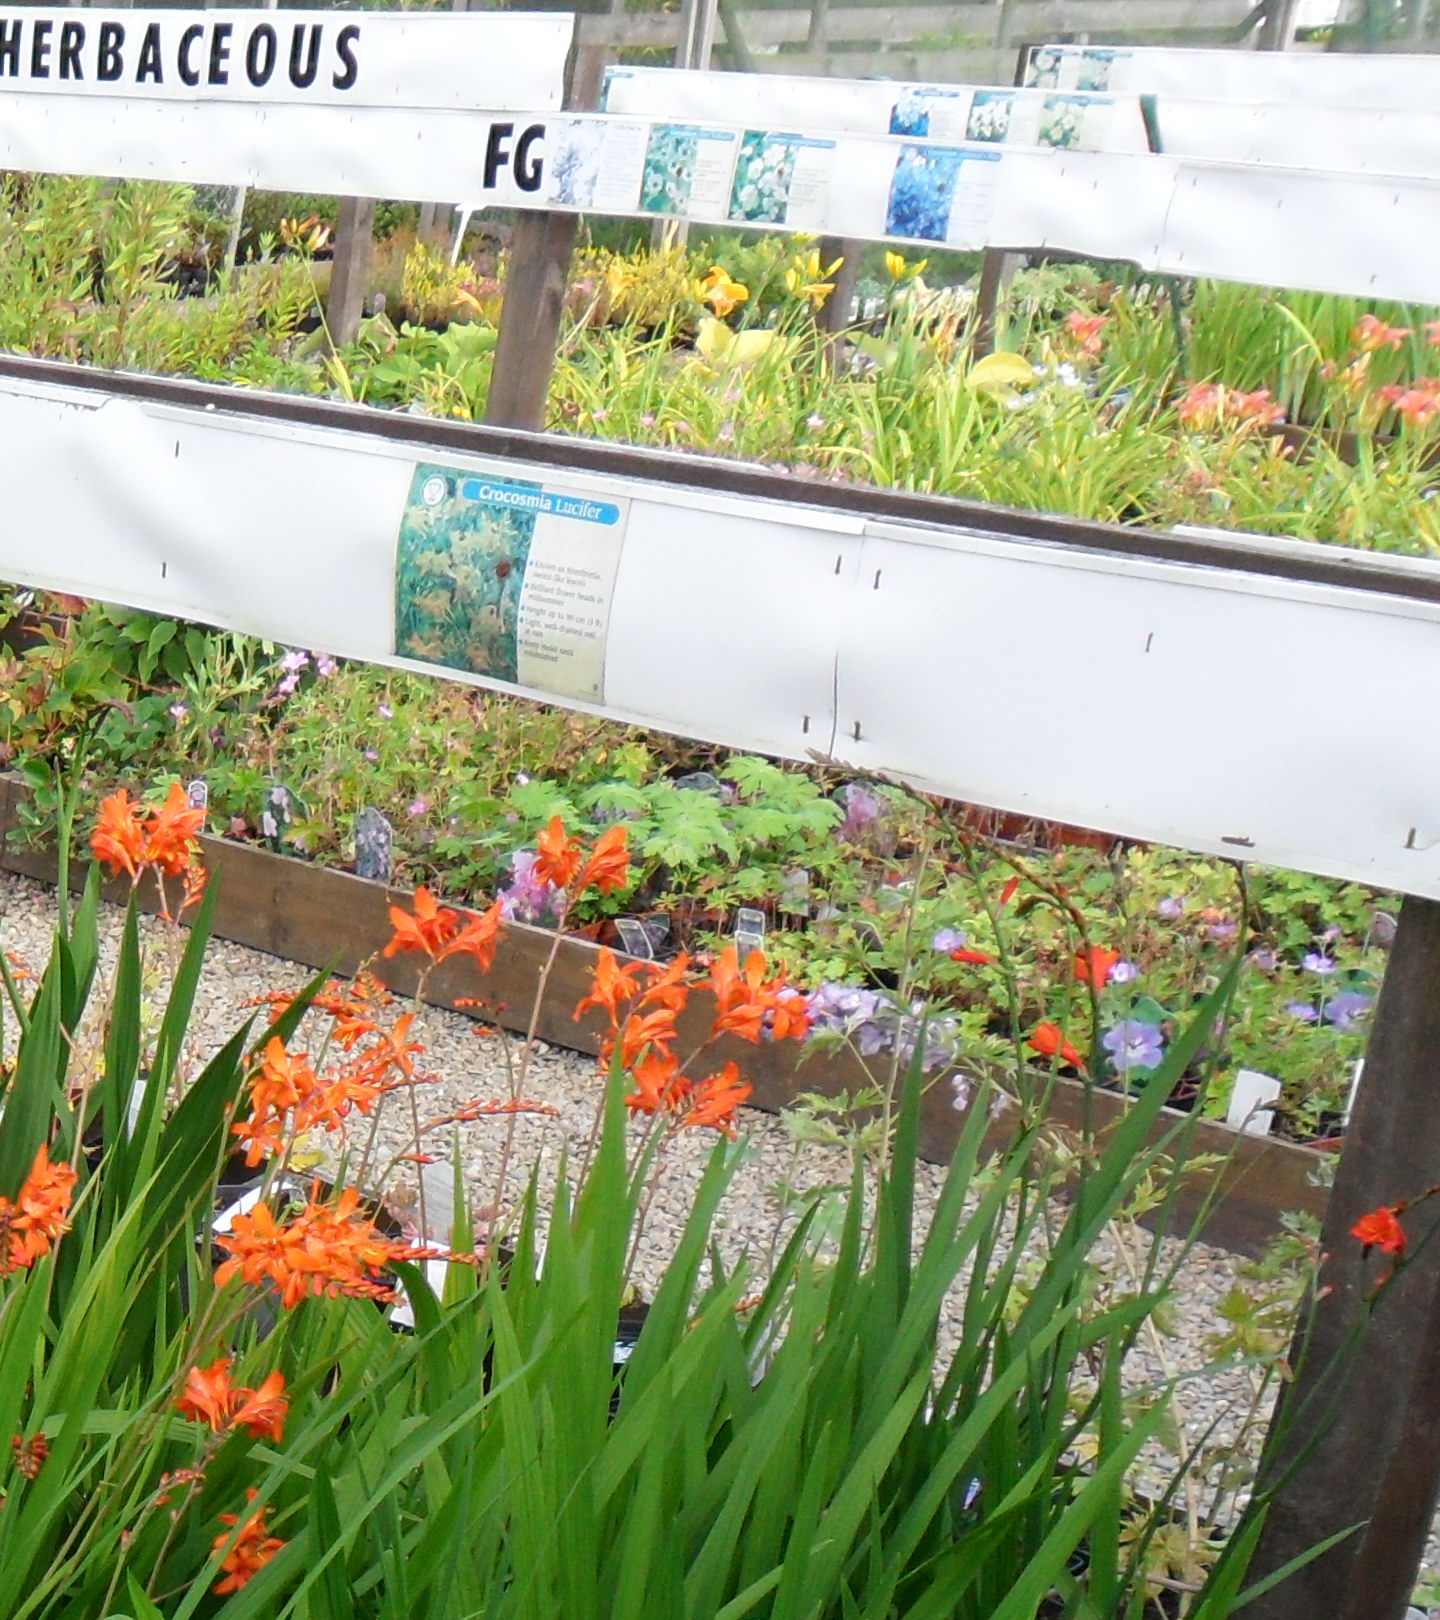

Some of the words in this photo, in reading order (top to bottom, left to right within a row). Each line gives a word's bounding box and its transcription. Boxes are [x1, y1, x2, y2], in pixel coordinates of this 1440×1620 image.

[483, 122, 546, 192] FG
[479, 485, 552, 511] Crocosmia
[555, 498, 603, 519] Lucifer
